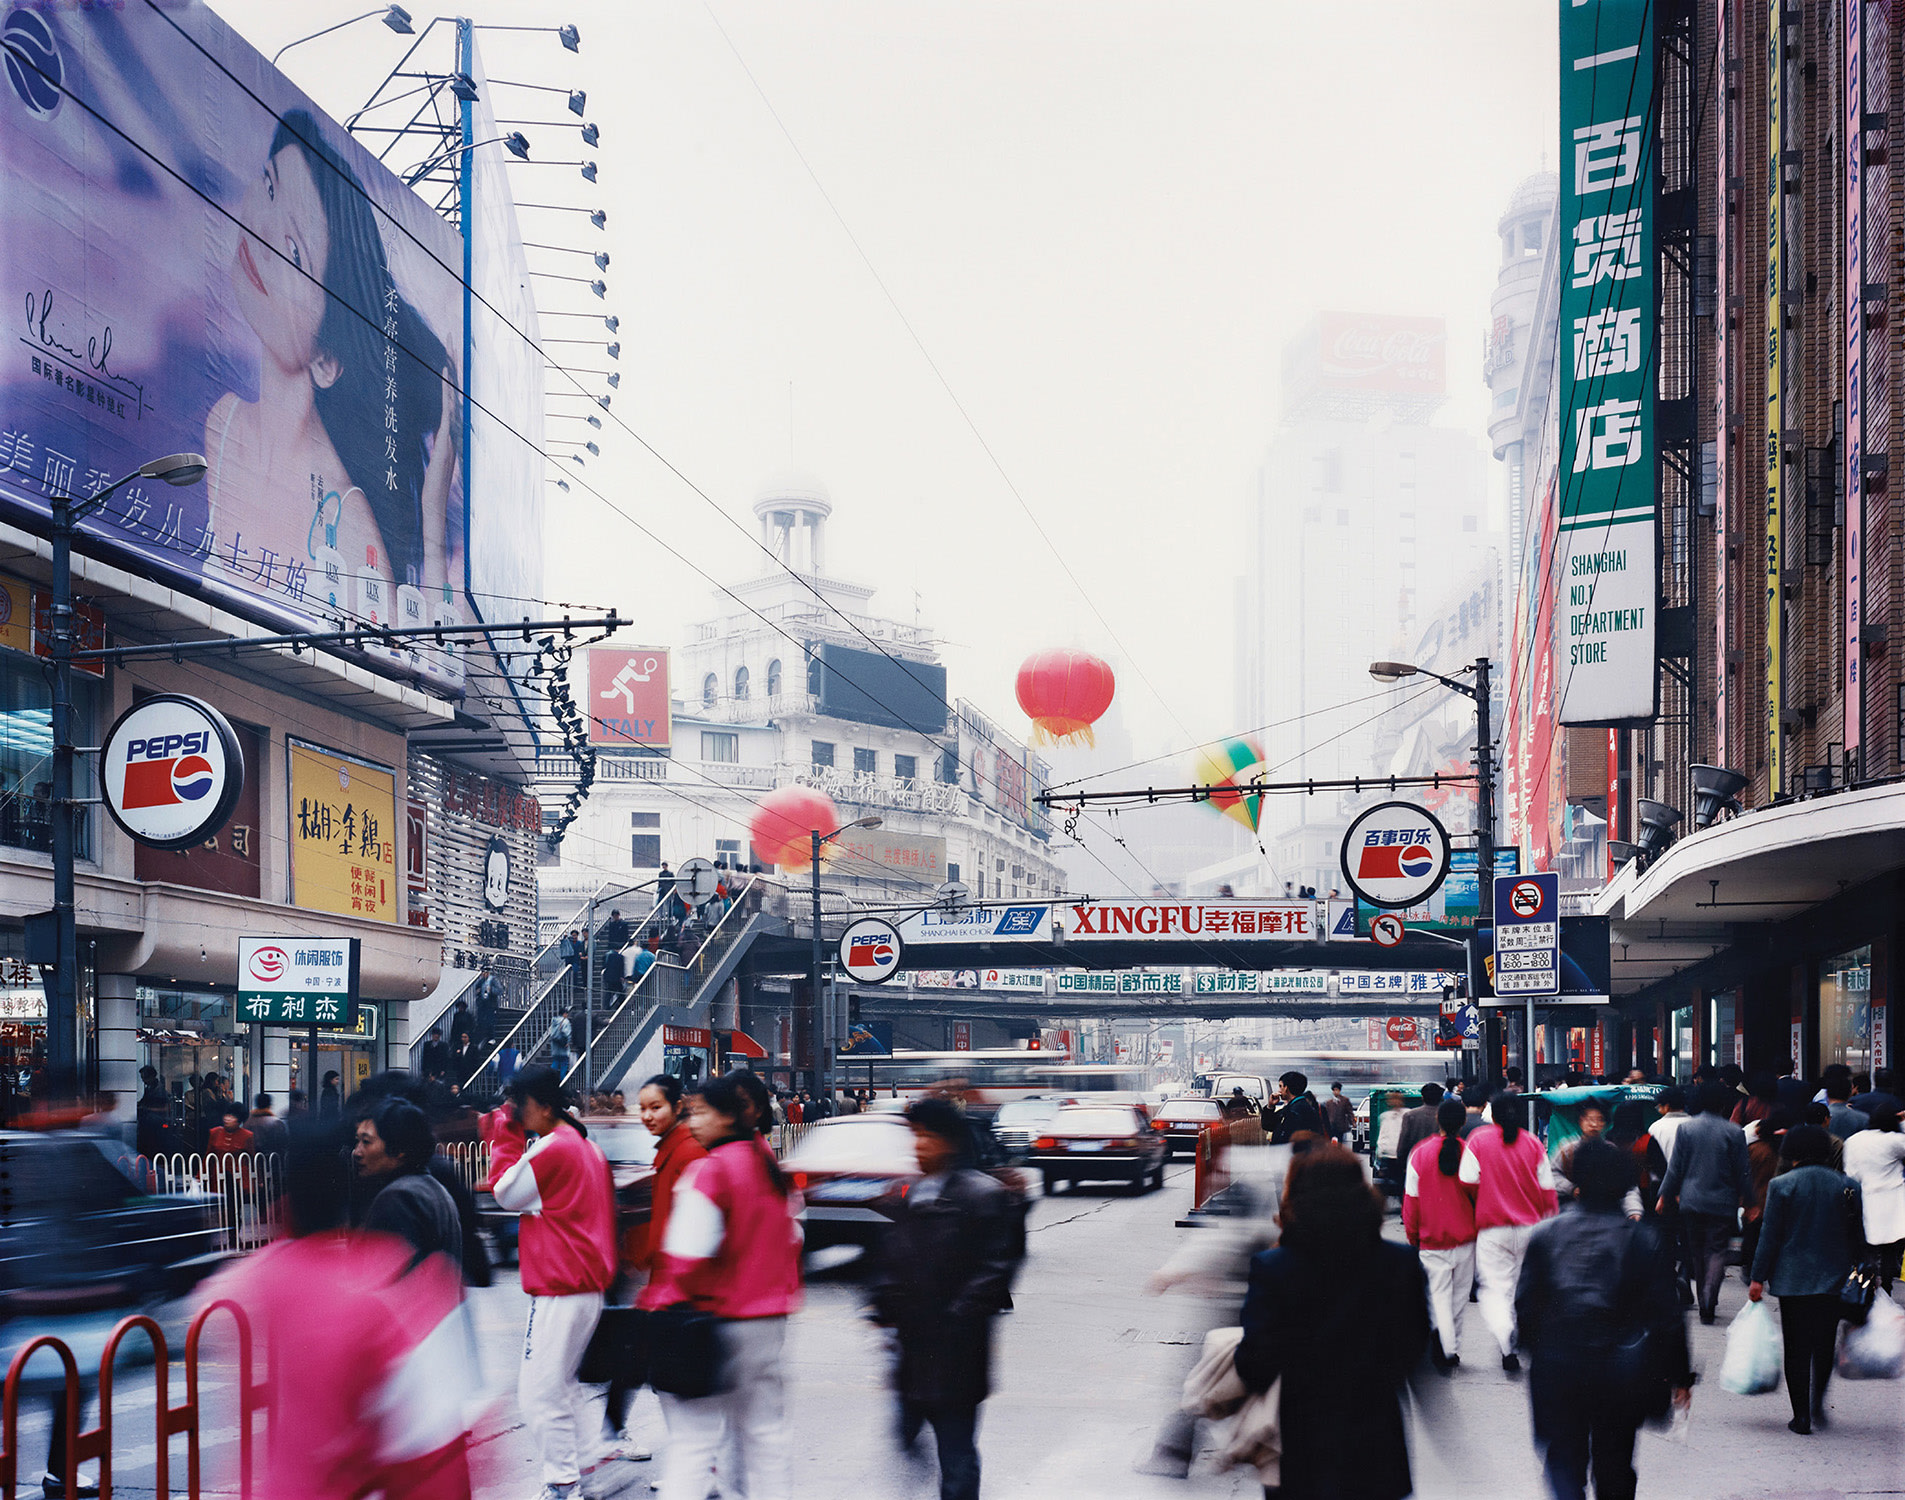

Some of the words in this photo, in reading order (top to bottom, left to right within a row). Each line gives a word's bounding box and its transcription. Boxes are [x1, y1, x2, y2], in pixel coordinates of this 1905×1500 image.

[1572, 0, 1643, 475] 一百货商店
[325, 561, 339, 580] LUX
[1571, 549, 1627, 577] SHANGHAI
[366, 581, 379, 599] LUX
[1570, 583, 1593, 606] NO.1
[406, 598, 419, 616] LUX
[1570, 608, 1645, 636] DEPARTMENT
[1570, 641, 1607, 666] STORE
[602, 718, 656, 738] ITALY
[127, 731, 209, 762] PEPSI
[1364, 828, 1431, 846] 百事可乐
[1073, 906, 1204, 934] XINGFU
[1205, 910, 1308, 934] 幸福摩托
[851, 934, 892, 946] PEPSI
[921, 929, 958, 937] SHANGHAI
[970, 928, 992, 936] CHOR
[294, 950, 343, 967] 休闲服饰
[1503, 960, 1522, 969] 16:00
[1531, 958, 1550, 967] 18:00
[1505, 953, 1520, 961] 7:30
[1532, 951, 1548, 960] 9:00
[1002, 973, 1043, 987] 上海大江集团
[1059, 974, 1117, 991] 中国精品
[1122, 974, 1182, 992] 舒而挺
[1217, 973, 1257, 991] 衬衫
[1342, 975, 1402, 989] 中国名牌
[245, 994, 339, 1020] 布利杰
